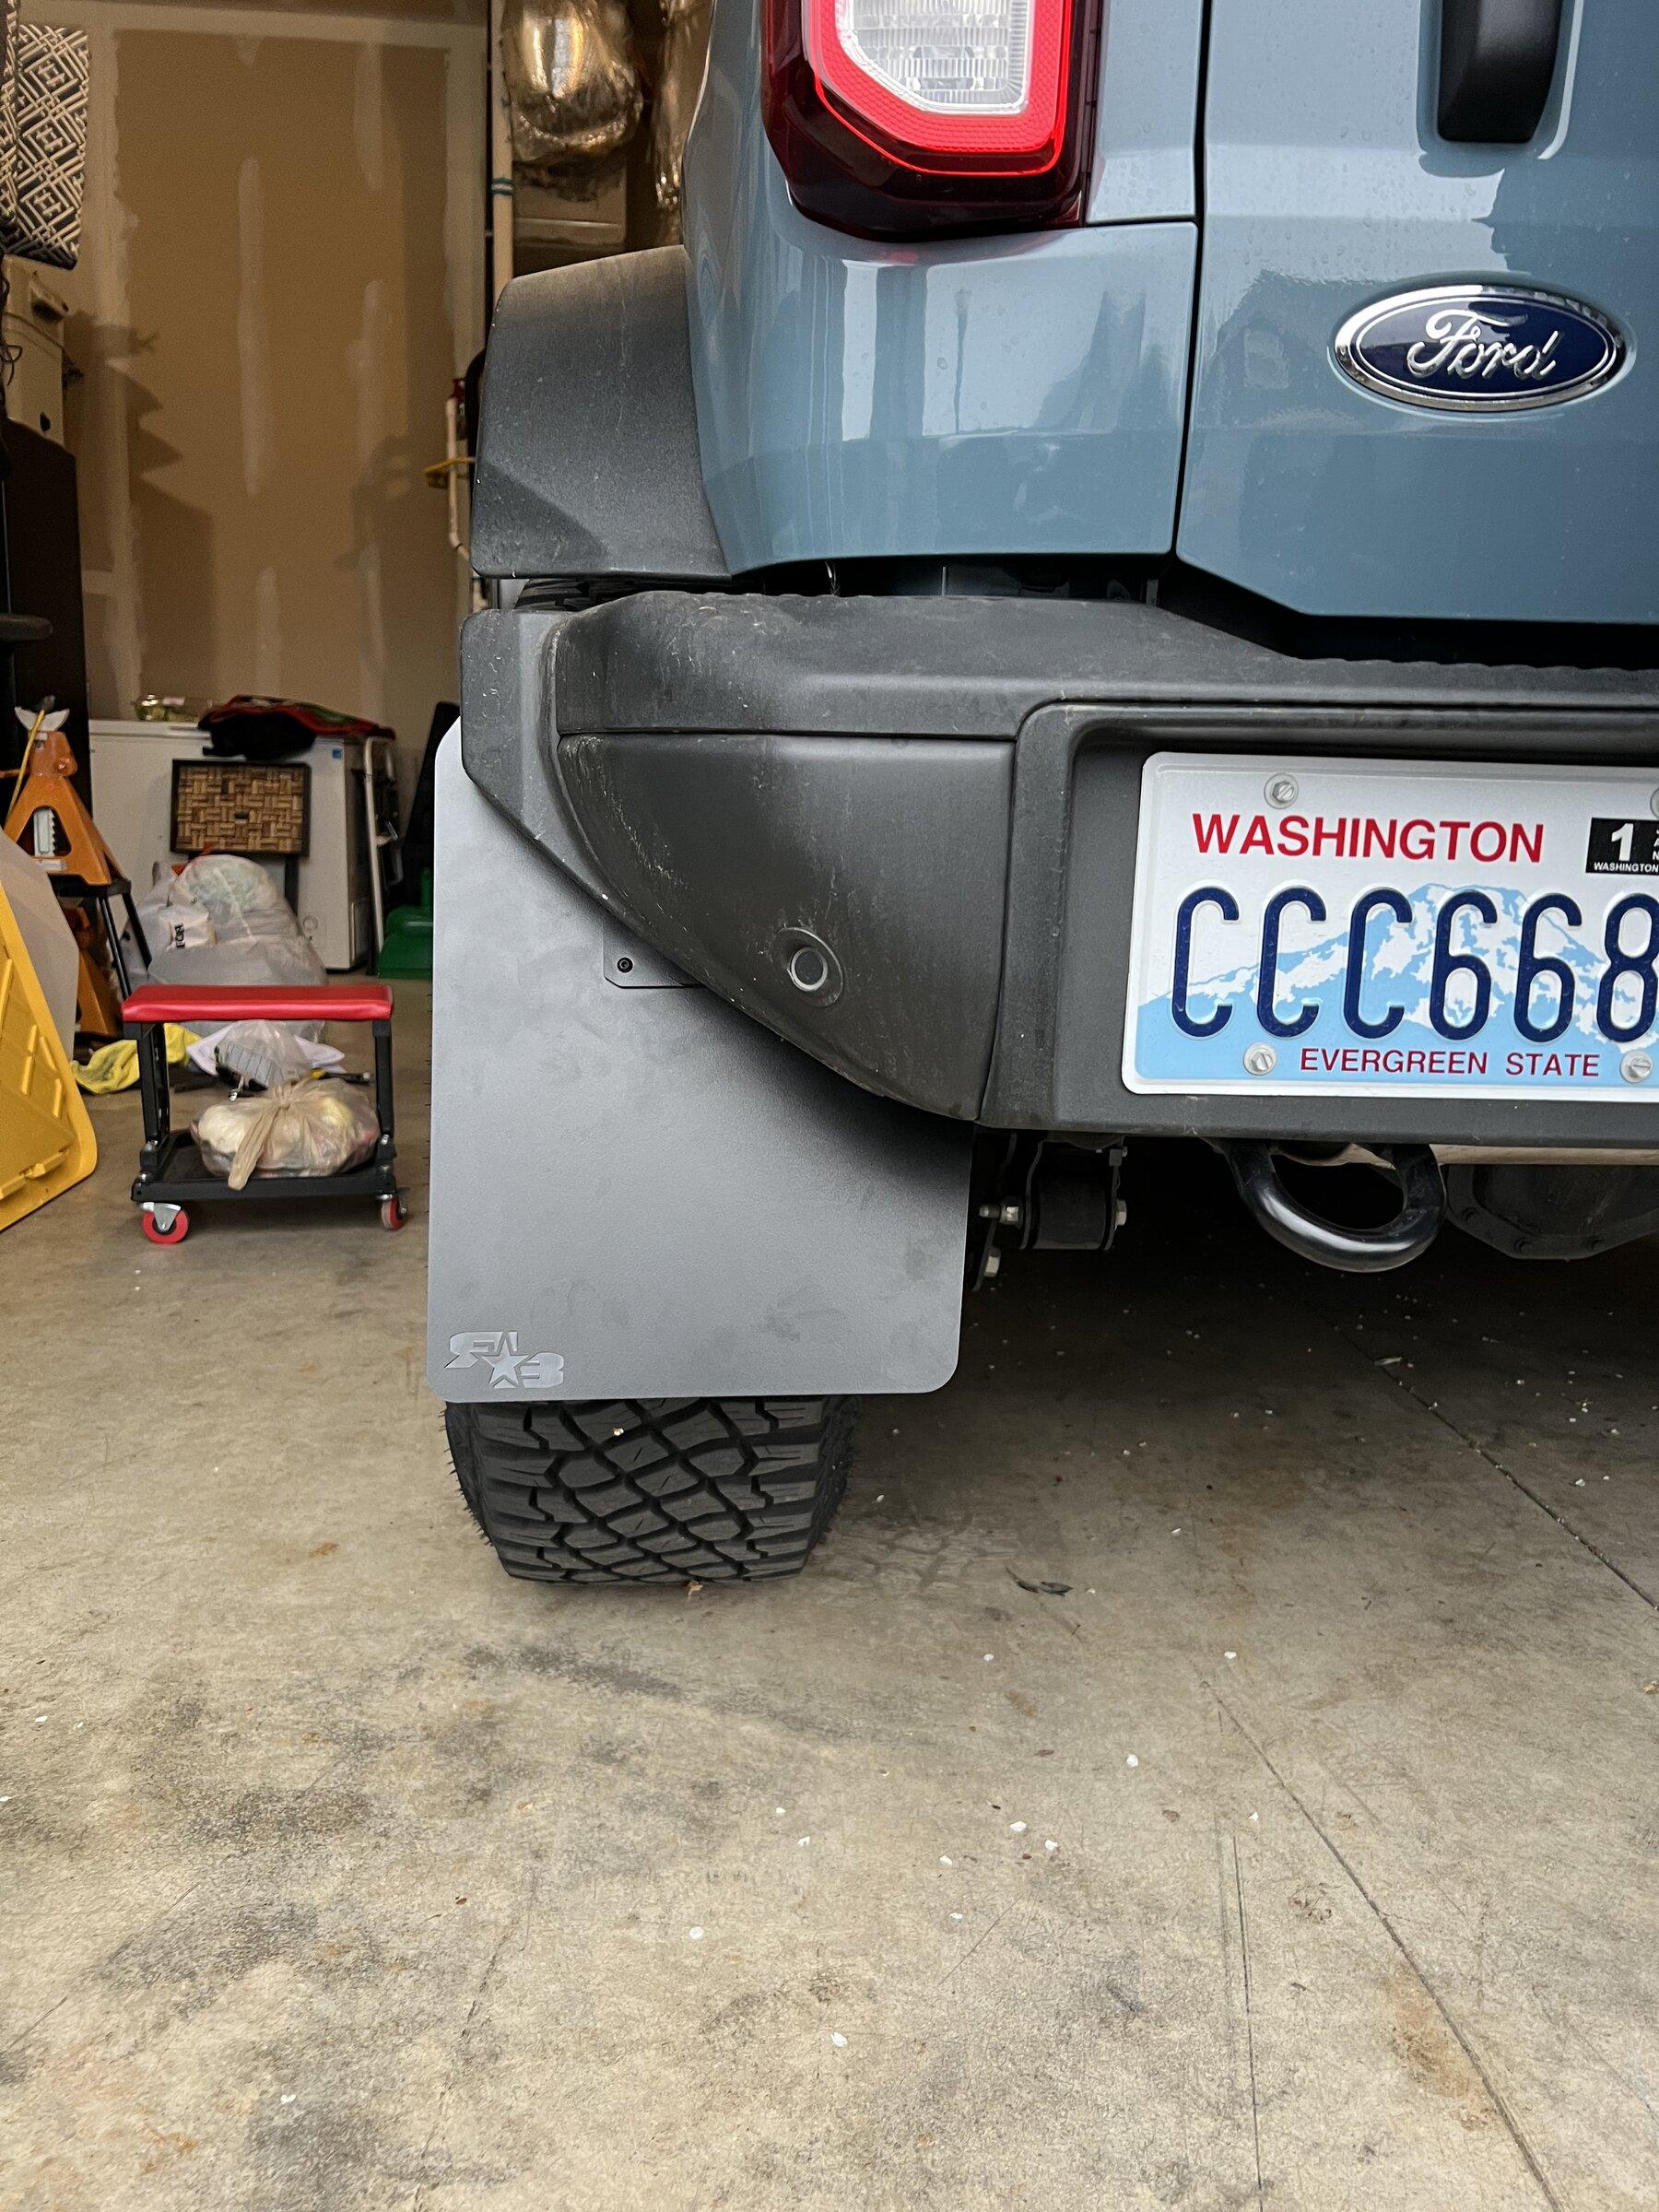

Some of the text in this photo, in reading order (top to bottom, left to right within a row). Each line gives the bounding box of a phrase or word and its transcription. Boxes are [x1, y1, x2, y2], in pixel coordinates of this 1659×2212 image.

[1406, 309, 1563, 379] Ford
[1192, 813, 1545, 864] WASHINGTON
[1594, 862, 1659, 873] WASHINGTON
[1171, 887, 1659, 1042] CCC668
[1300, 1048, 1600, 1077] EVERGREEN STATE
